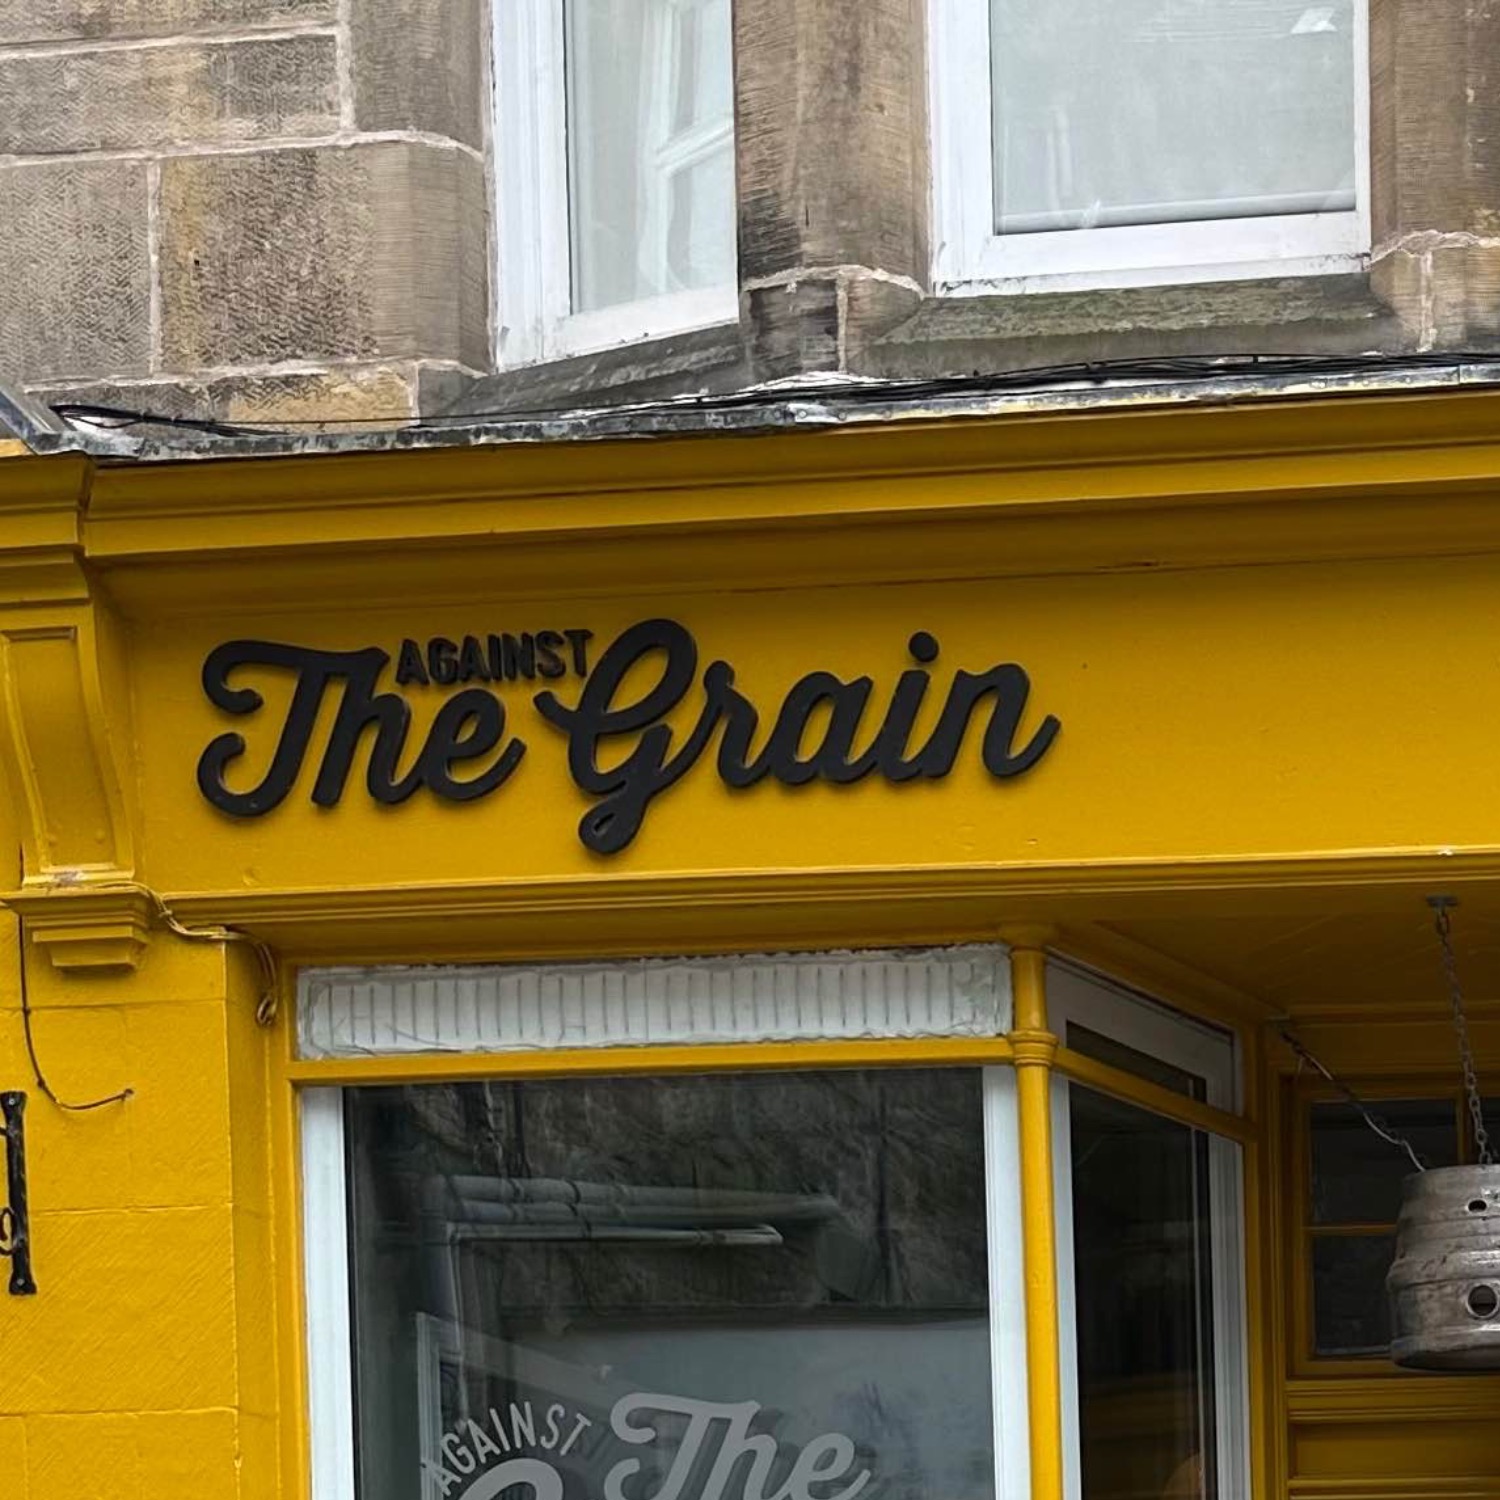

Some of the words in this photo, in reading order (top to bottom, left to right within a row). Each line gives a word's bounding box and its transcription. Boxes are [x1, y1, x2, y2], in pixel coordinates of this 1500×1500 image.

[396, 628, 594, 687] AGAINST
[197, 638, 528, 818] The
[534, 619, 1062, 856] Grain
[420, 1401, 592, 1497] AGAINST
